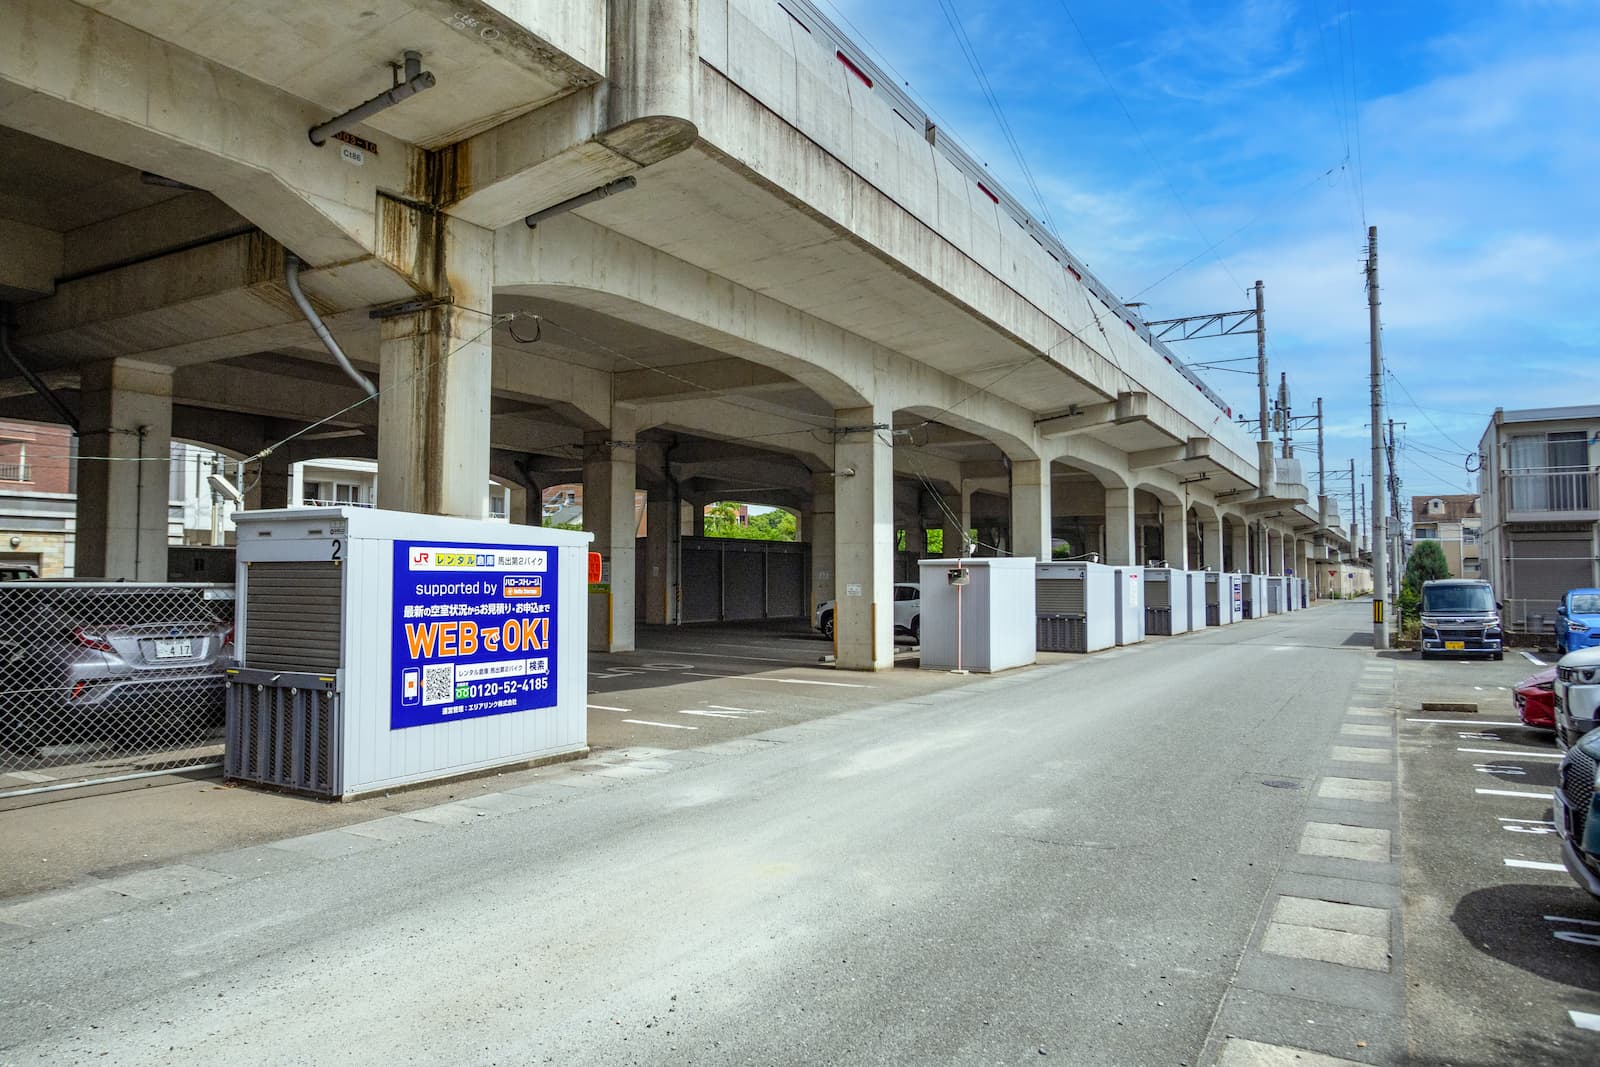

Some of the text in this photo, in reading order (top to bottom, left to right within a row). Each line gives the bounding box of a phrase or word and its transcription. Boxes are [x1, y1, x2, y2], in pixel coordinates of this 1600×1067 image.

[331, 539, 341, 560] 2
[414, 552, 429, 563] JR
[415, 581, 479, 596] supported
[484, 581, 497, 595] by
[529, 660, 545, 671] 検索
[469, 677, 548, 698] 0120-52-4185
